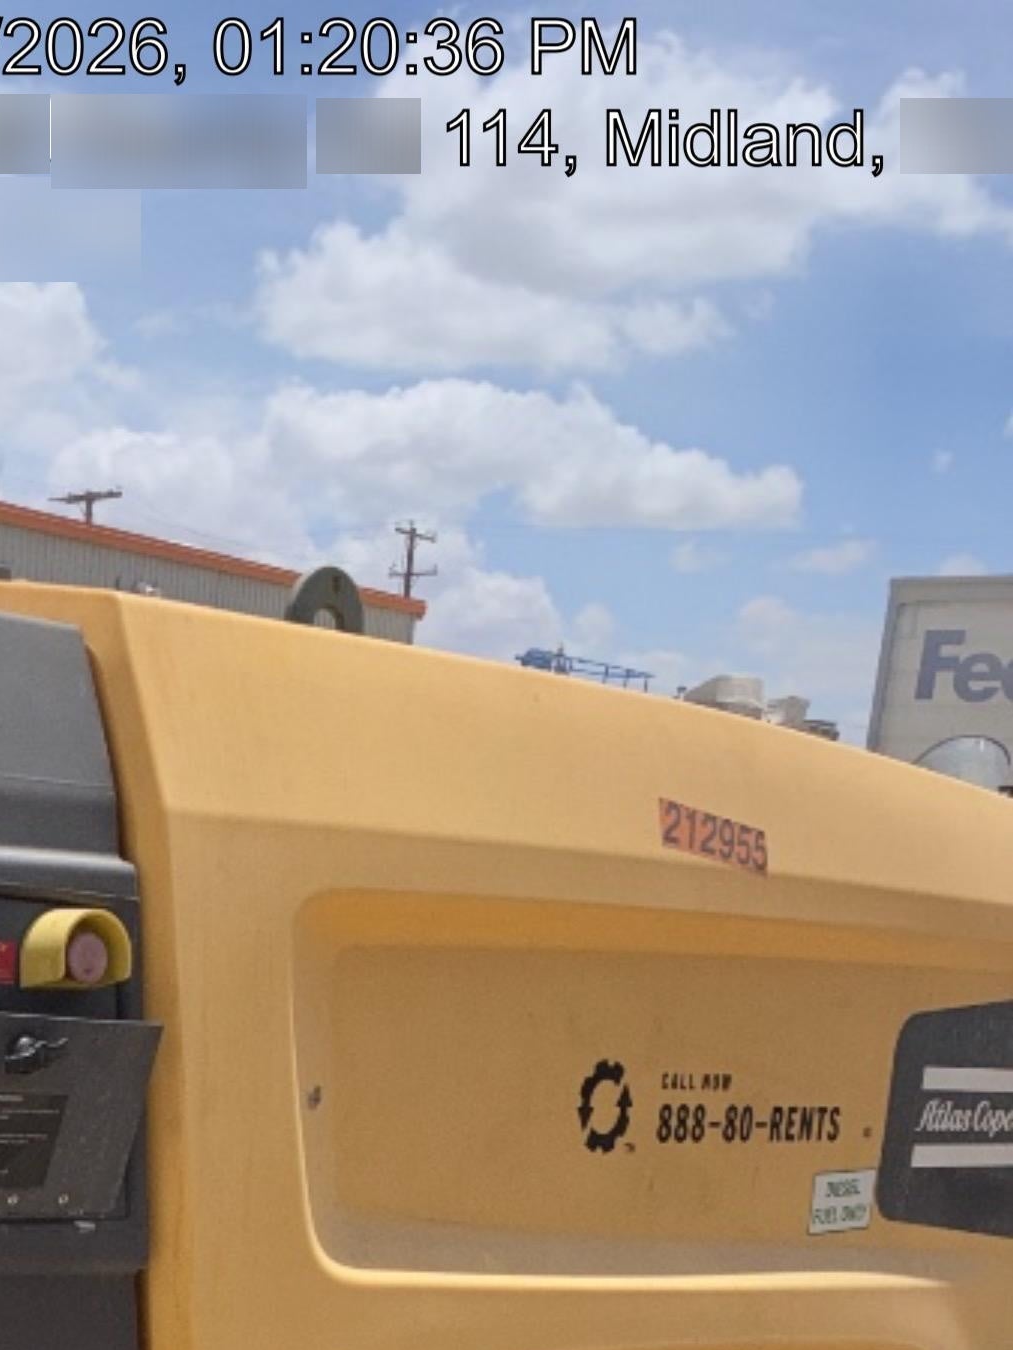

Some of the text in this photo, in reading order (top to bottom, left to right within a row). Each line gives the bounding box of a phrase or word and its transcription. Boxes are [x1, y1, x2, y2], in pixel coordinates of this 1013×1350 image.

[914, 629, 1013, 703] Fe
[662, 799, 768, 872] 212955
[661, 1073, 732, 1090] CALL NOW
[656, 1103, 841, 1143] 888-80-RENTS
[914, 1098, 972, 1132] Atlas
